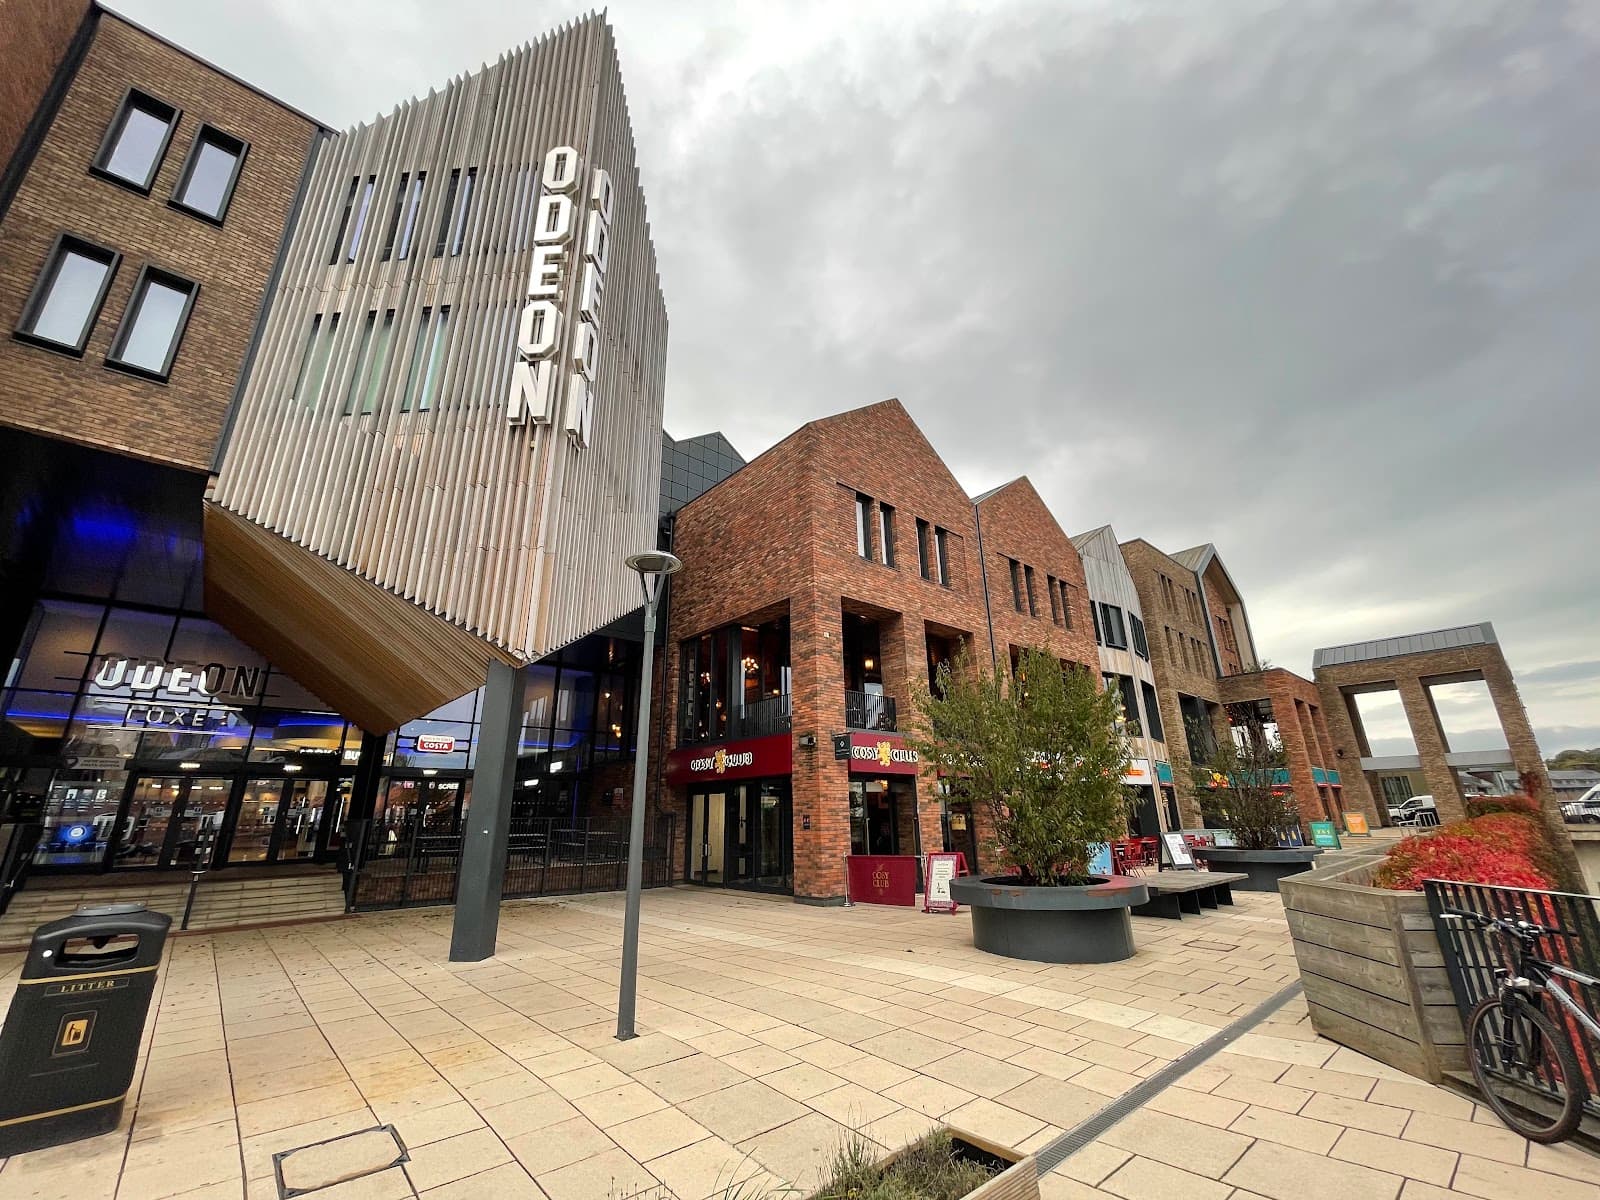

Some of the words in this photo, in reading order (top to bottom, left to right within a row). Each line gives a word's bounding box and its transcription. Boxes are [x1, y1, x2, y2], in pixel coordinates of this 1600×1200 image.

[507, 145, 580, 426] ODEON
[566, 168, 614, 451] ODEON
[95, 653, 261, 699] ODEON
[424, 742, 449, 750] COSTA
[851, 745, 878, 760] COSY
[890, 748, 918, 763] CLUB
[690, 757, 715, 771] COSY
[724, 752, 753, 767] CLUB
[872, 871, 890, 880] COSY
[872, 879, 890, 888] CLUB
[60, 980, 115, 993] LITTER
